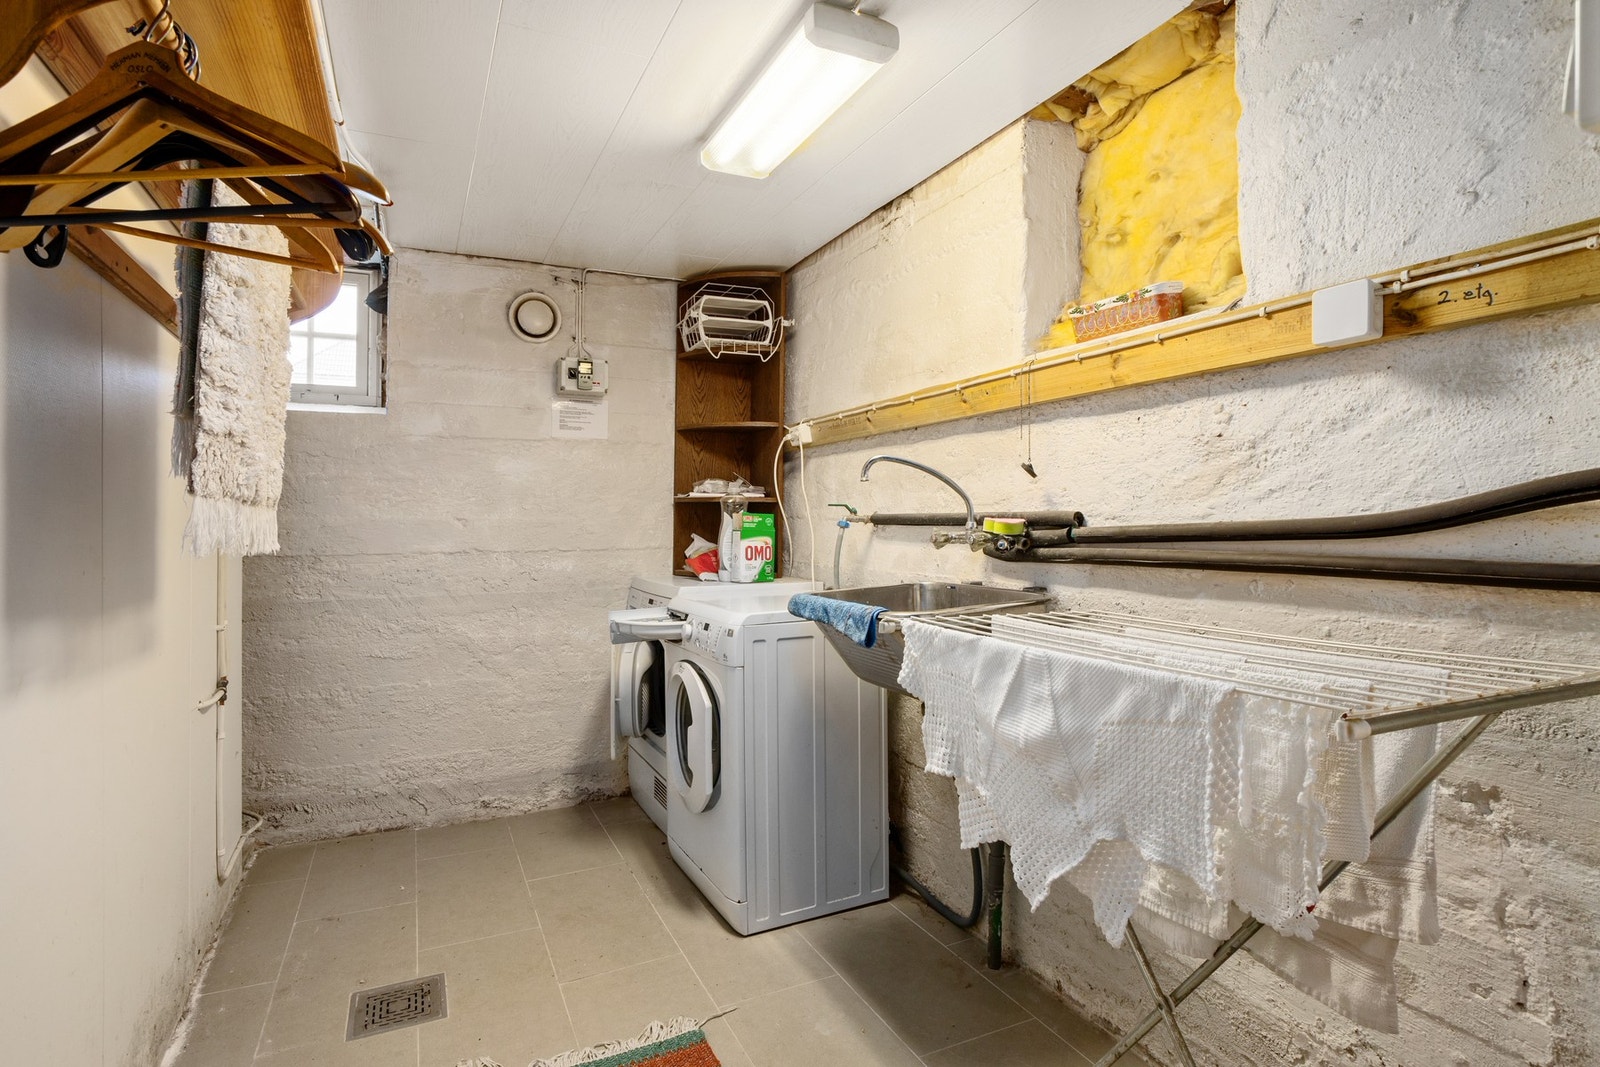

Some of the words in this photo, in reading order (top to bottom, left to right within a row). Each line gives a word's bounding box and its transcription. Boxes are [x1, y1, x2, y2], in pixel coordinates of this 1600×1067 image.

[127, 64, 154, 74] OSLO
[1437, 290, 1458, 305] 2.
[1463, 283, 1499, 306] etg.
[745, 545, 772, 561] OMO
